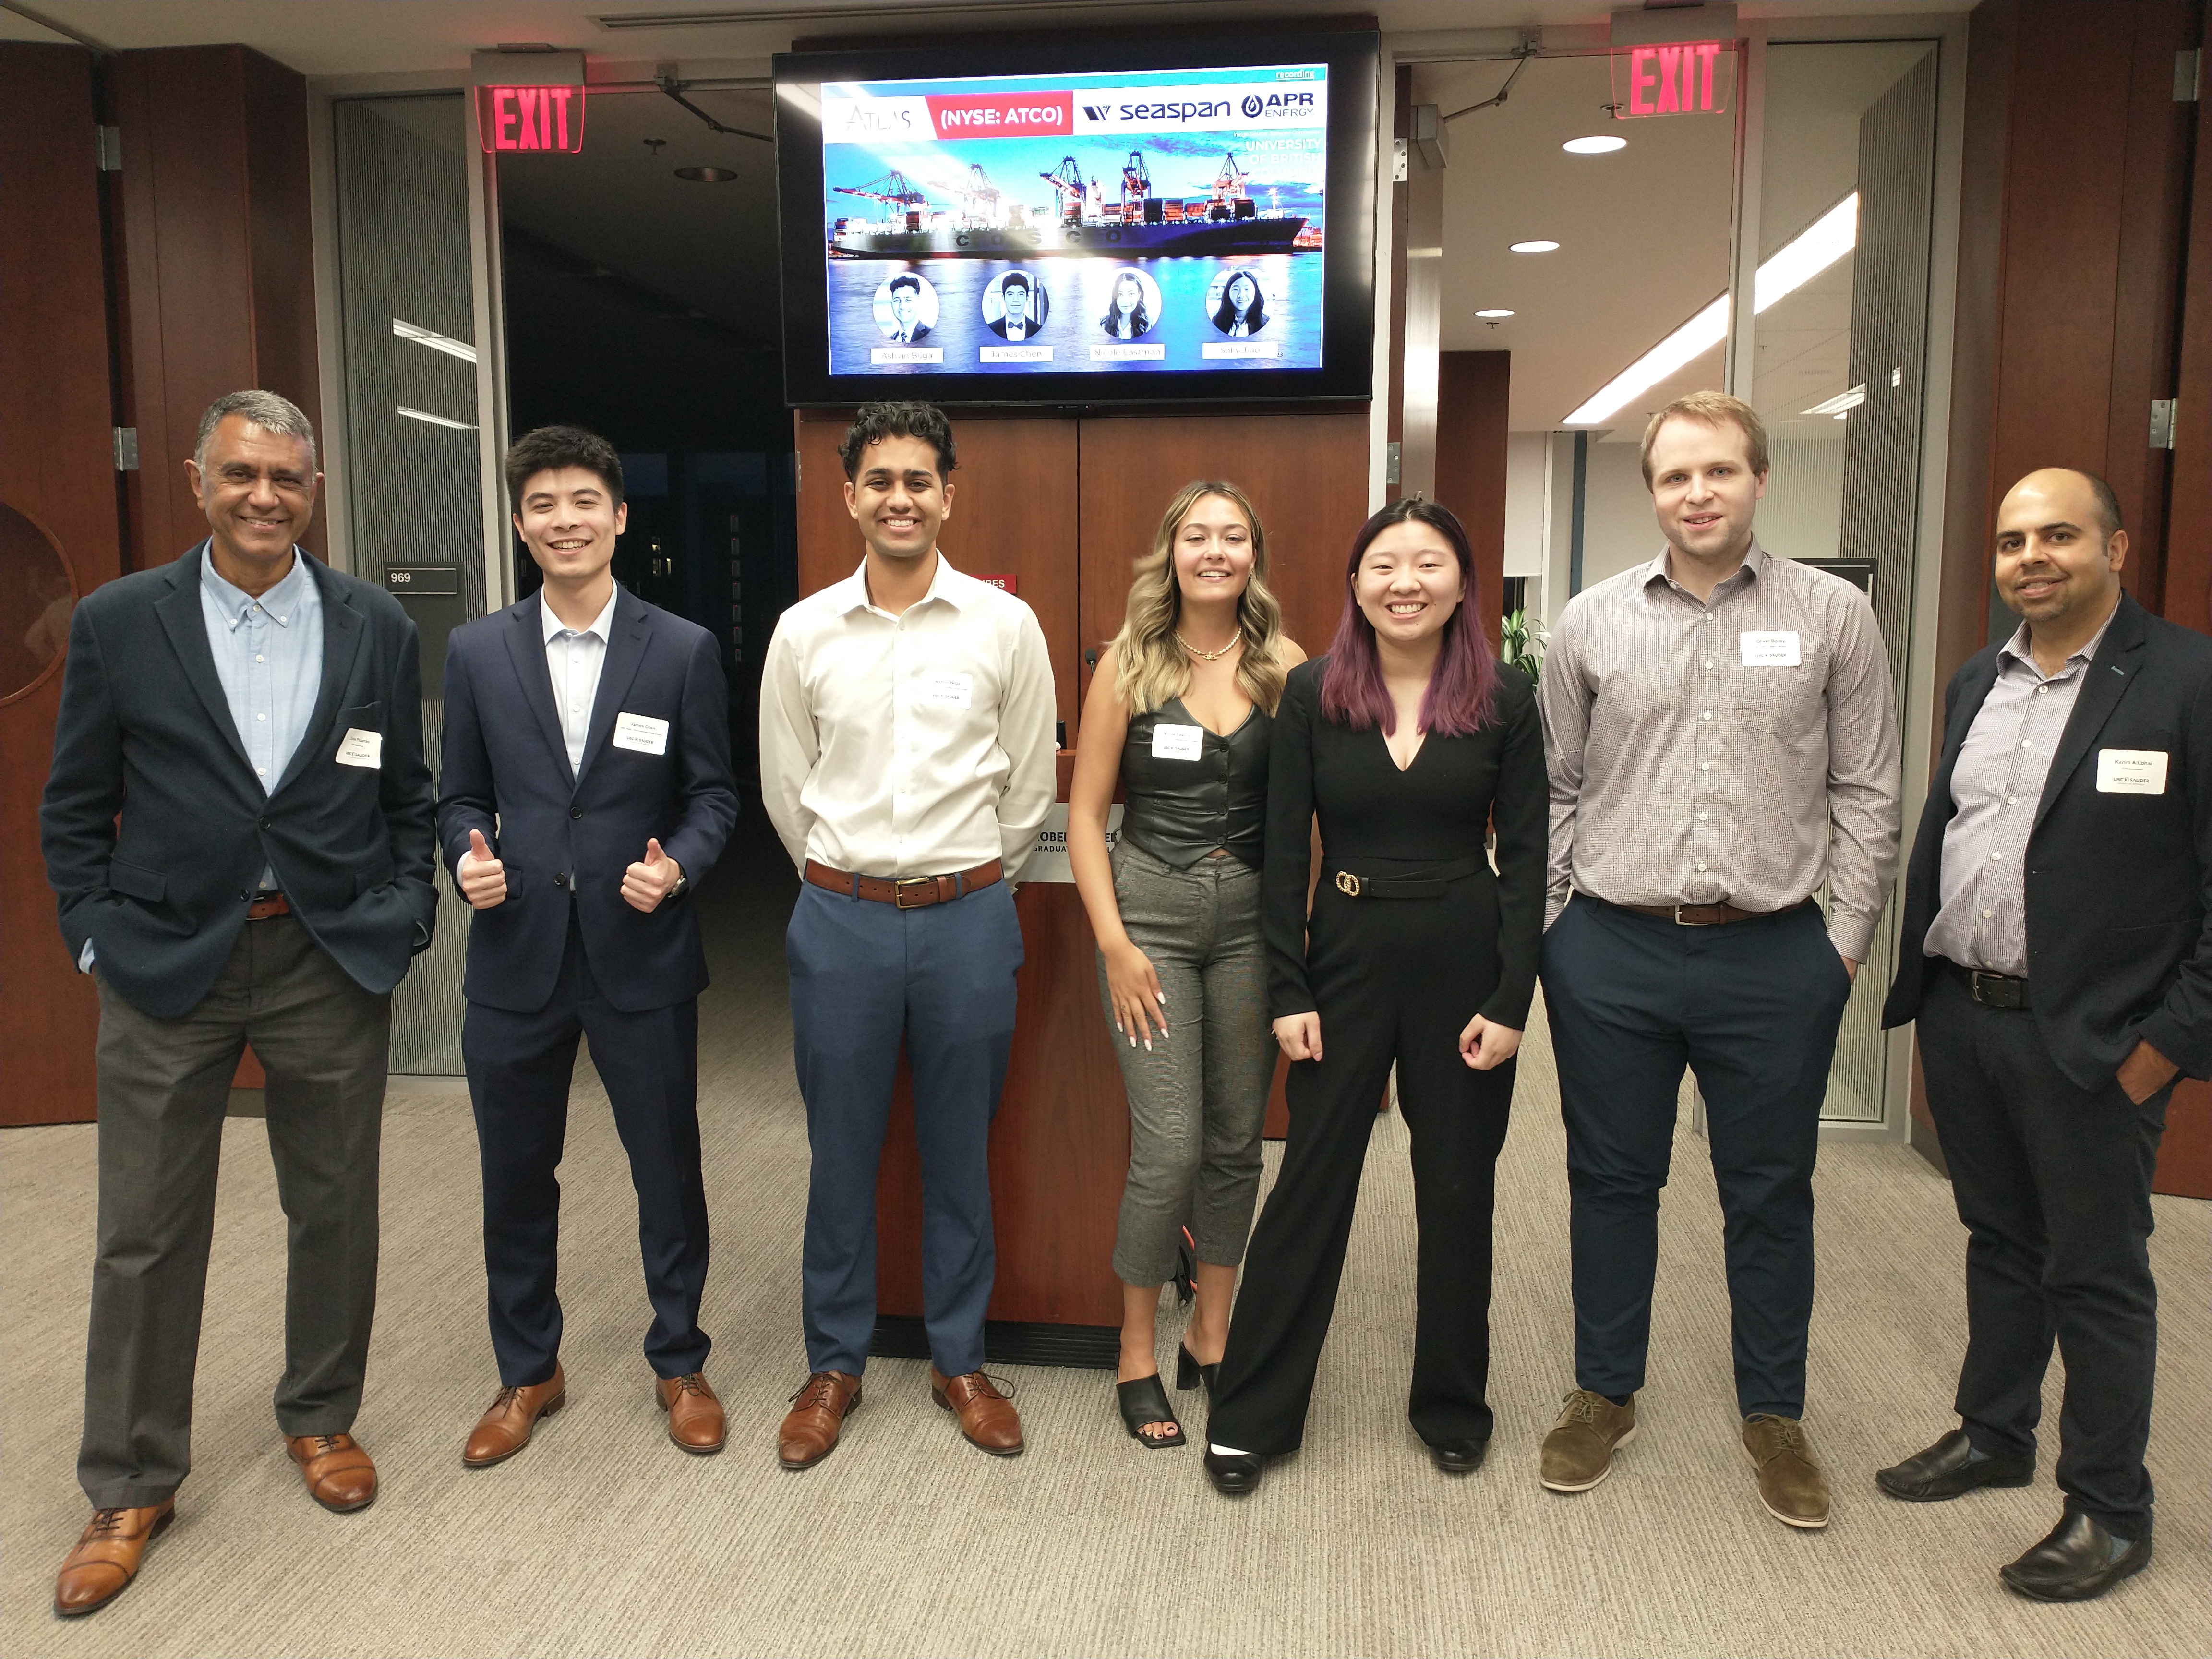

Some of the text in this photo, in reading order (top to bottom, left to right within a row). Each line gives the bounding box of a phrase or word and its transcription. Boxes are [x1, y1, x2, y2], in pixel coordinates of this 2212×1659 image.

[1276, 69, 1314, 81] recording
[1631, 44, 1720, 114] EXIT
[1265, 92, 1314, 107] APR
[941, 106, 1063, 130] (NYSE: ATCO)
[1120, 101, 1231, 123] seaspan
[1265, 108, 1314, 118] ENERGY
[493, 89, 571, 150] EXIT
[1246, 138, 1322, 151] UNIVERSITY
[1249, 152, 1321, 165] OF BRITISH
[912, 352, 933, 360] Bilga
[1220, 347, 1239, 355] Sally
[391, 573, 411, 583] 969
[983, 579, 1005, 588] RES
[1038, 831, 1067, 842] OBE
